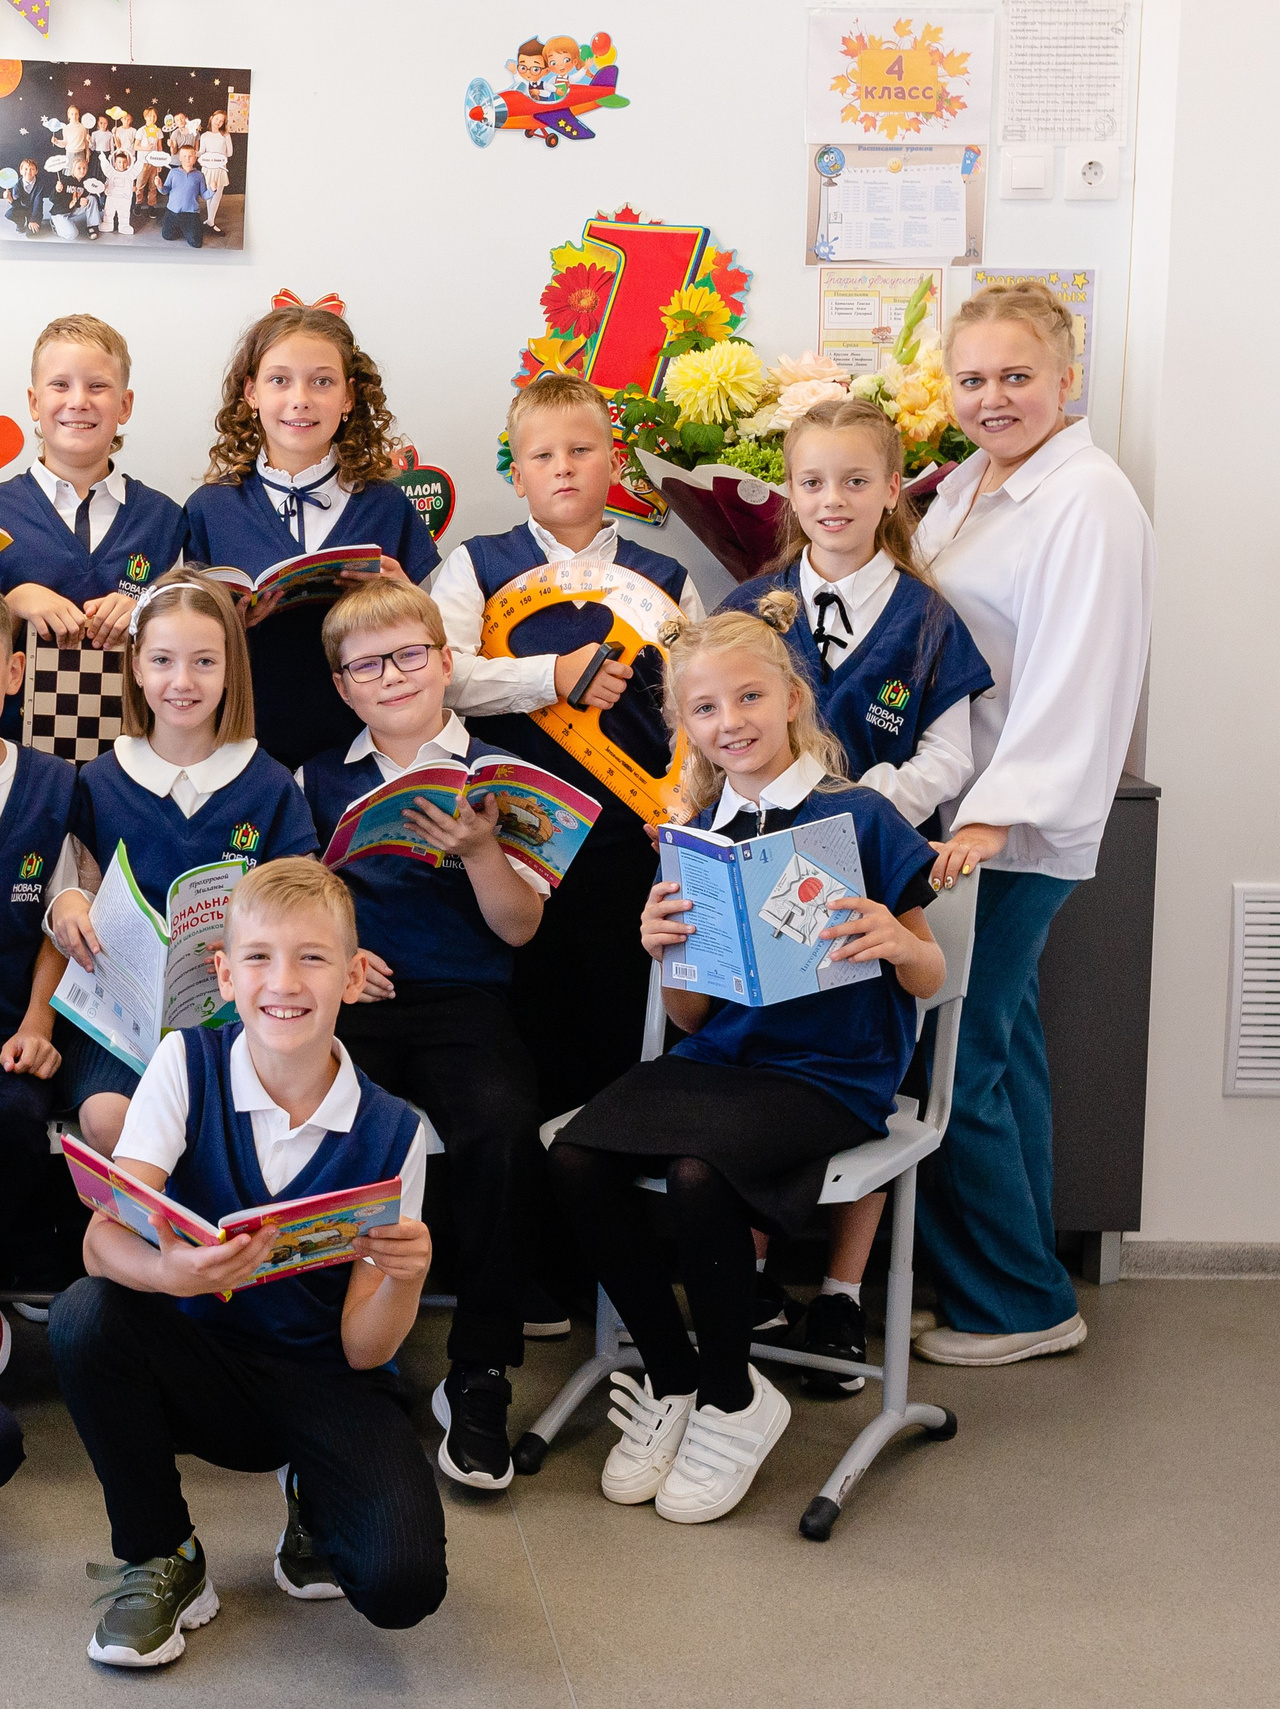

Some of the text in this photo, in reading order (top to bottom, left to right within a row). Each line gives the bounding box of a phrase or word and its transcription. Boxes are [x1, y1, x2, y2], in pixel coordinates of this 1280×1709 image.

[885, 55, 904, 82] 4
[864, 83, 934, 101] класс
[868, 273, 925, 289] дежурств
[538, 575, 548, 584] 40
[561, 570, 636, 592] 50 60 70 80
[518, 585, 528, 594] 30
[538, 587, 552, 596] 140
[559, 582, 632, 606] 130 120 110 100
[499, 598, 508, 608] 20
[520, 595, 532, 606] 150
[640, 598, 652, 612] 90
[502, 606, 515, 619] 160
[488, 622, 500, 635] 170
[868, 703, 904, 727] НОВАЯ
[865, 712, 899, 736] ШКОЛА
[562, 728, 570, 737] 25
[584, 748, 592, 756] 30
[606, 768, 614, 777] 35
[629, 788, 638, 797] 40
[652, 808, 660, 818] 45
[759, 849, 769, 864] 4
[442, 860, 465, 870] ШКО
[188, 873, 229, 889] Прохоровой
[13, 883, 42, 894] НОВАЯ
[194, 884, 224, 896] Миланы
[10, 892, 40, 903] ШКОЛА
[170, 912, 224, 944] ОТНОСТЬ
[182, 924, 224, 942] ШКОЛЬНИКОВ
[800, 939, 825, 973] Литерату
